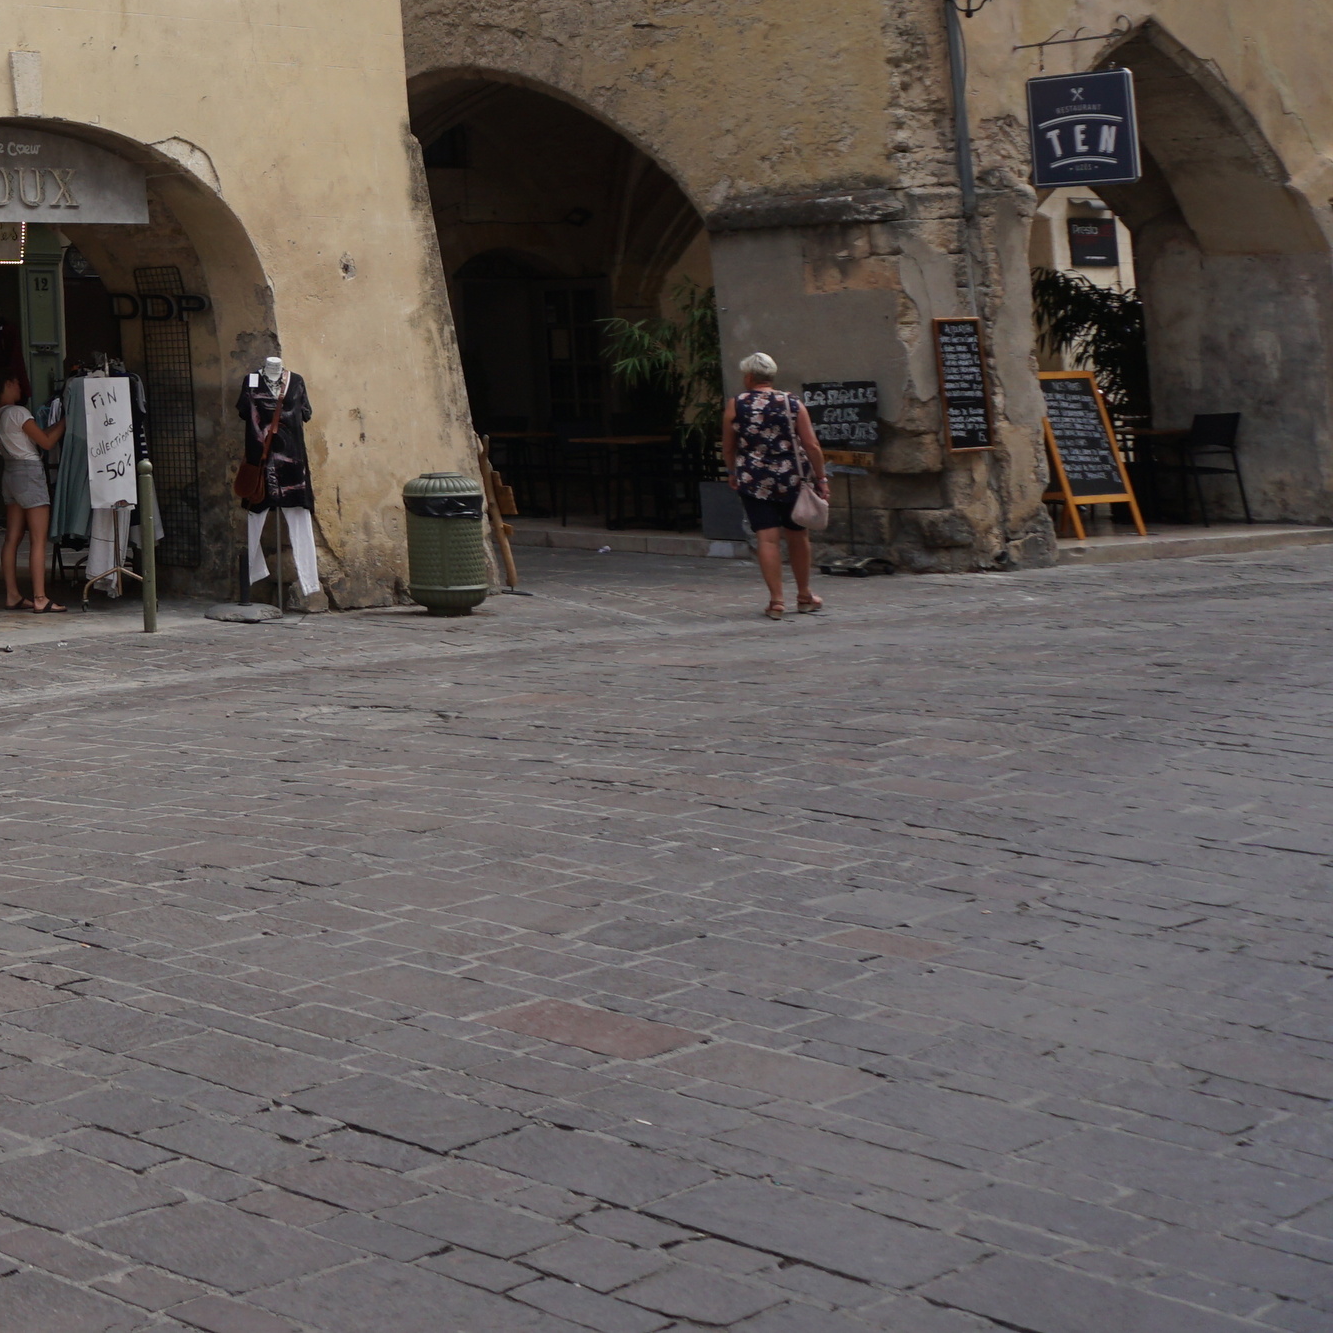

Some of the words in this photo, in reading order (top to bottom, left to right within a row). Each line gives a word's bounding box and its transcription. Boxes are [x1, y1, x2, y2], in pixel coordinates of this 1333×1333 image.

[1055, 103, 1102, 117] RESTAURANT
[1045, 123, 1118, 158] TEN
[34, 277, 49, 292] 12
[108, 292, 210, 322] DDP
[827, 386, 878, 405] MALLE
[103, 413, 116, 427] de
[96, 453, 133, 481] -50%
